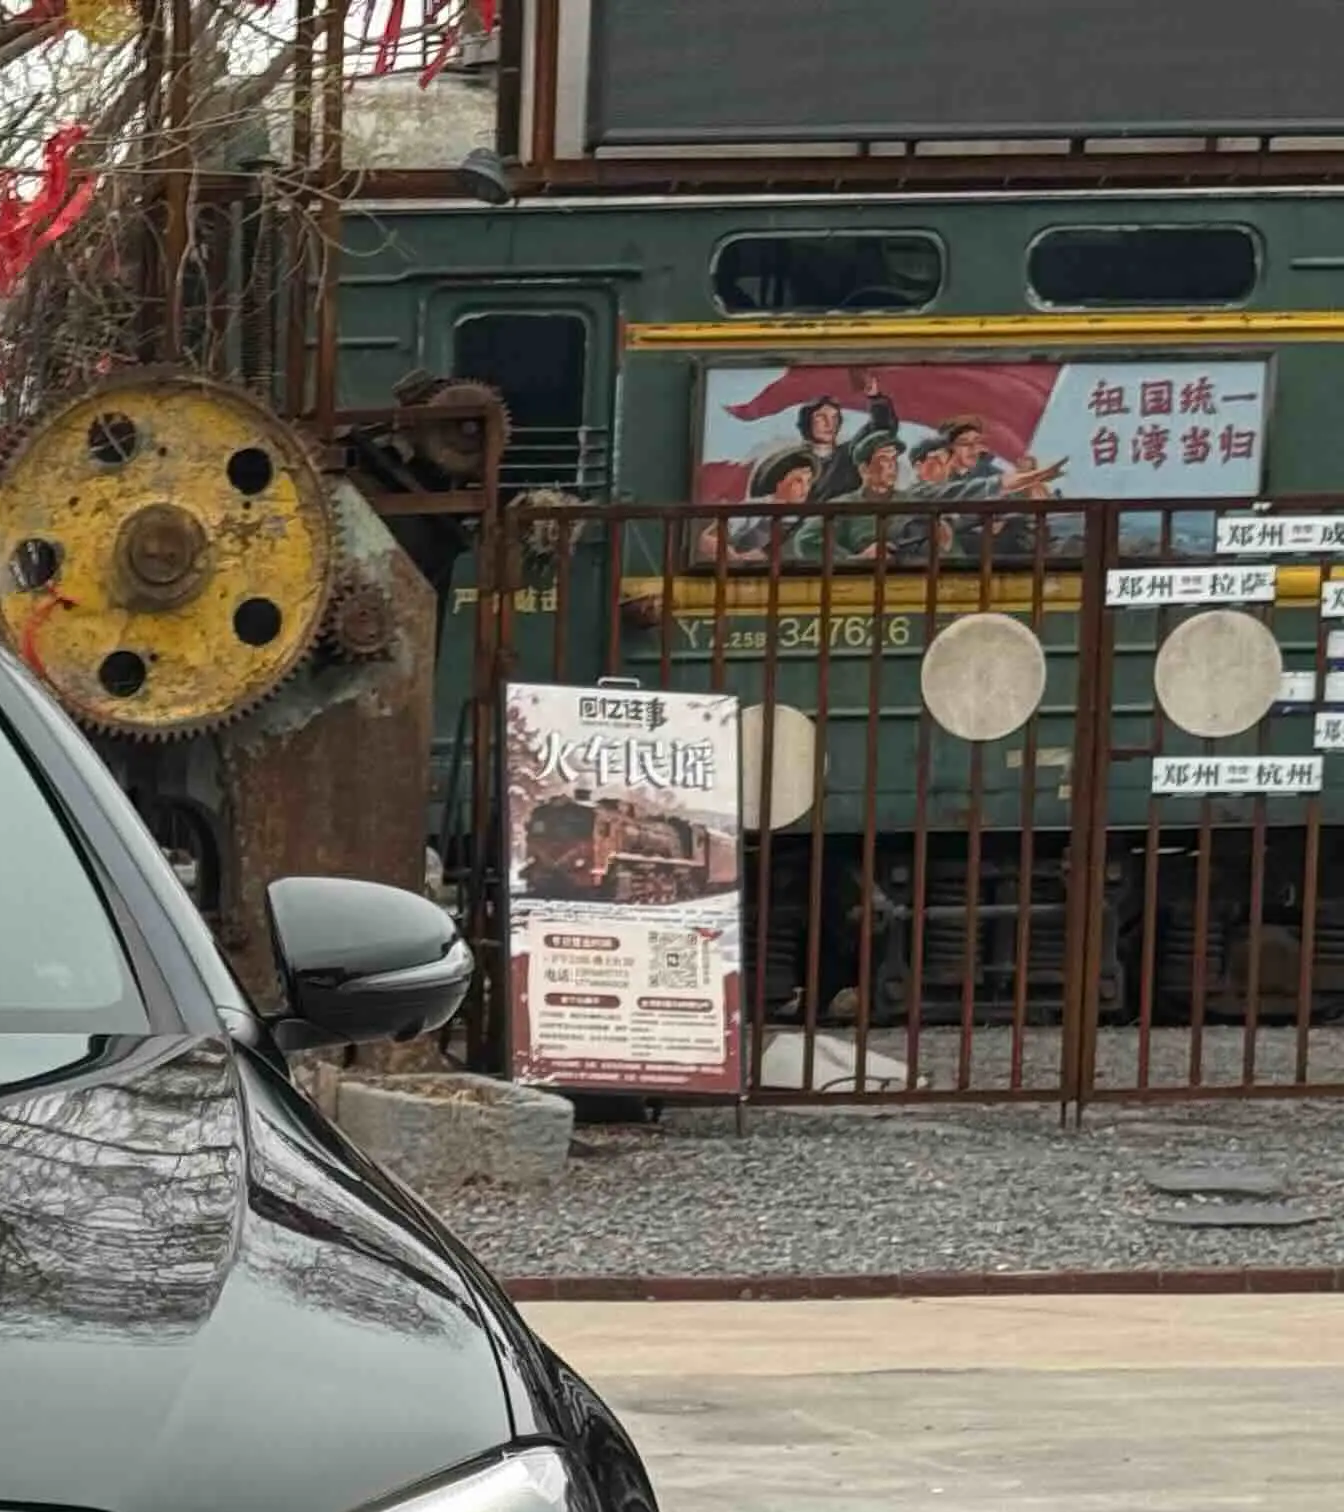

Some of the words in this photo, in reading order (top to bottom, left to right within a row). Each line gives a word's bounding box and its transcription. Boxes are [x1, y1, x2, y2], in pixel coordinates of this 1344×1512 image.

[1088, 376, 1257, 418] 祖国统一
[1090, 424, 1256, 469] 台湾当归
[579, 697, 670, 732] 回忆往事
[536, 731, 716, 791] 火车民谣
